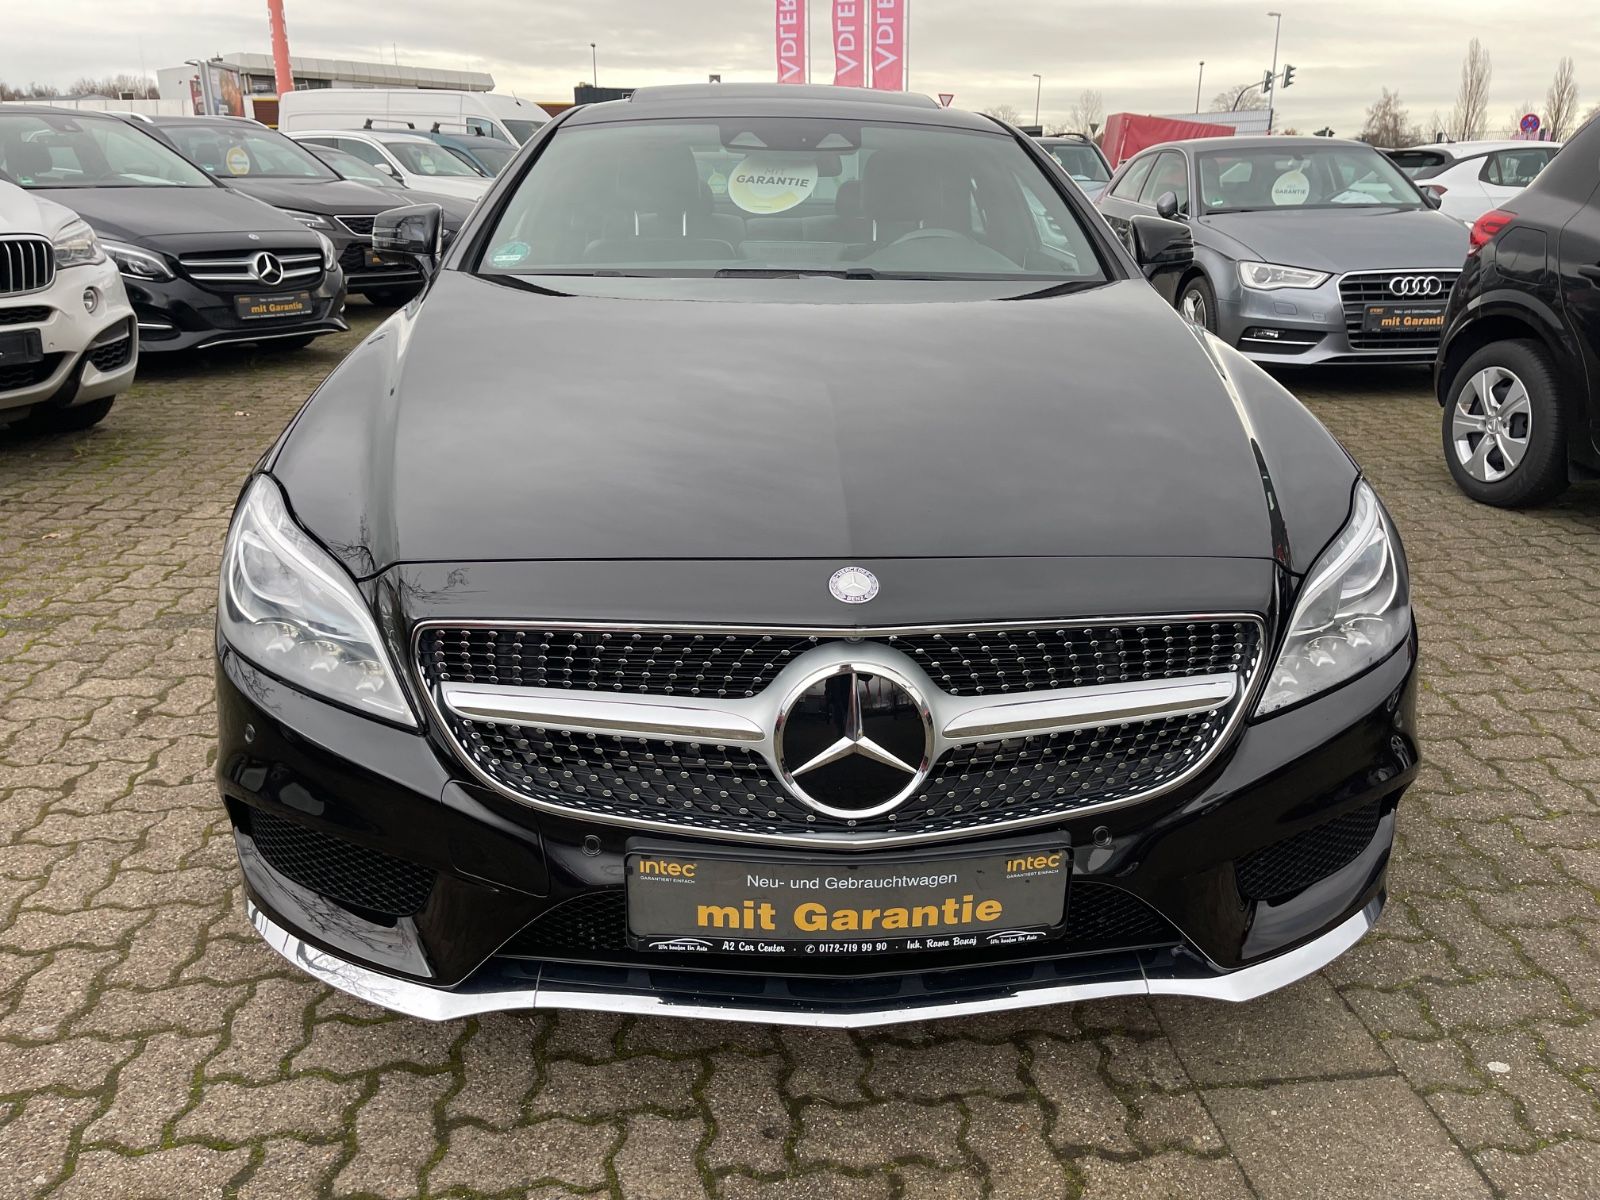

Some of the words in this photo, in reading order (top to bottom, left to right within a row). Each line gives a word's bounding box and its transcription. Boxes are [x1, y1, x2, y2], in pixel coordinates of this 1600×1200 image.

[736, 174, 810, 188] GARANTIE
[251, 304, 267, 313] mit
[269, 301, 303, 312] Garantie
[1381, 315, 1400, 326] mit
[1403, 315, 1445, 326] Garanti
[640, 860, 696, 878] intec
[1007, 854, 1060, 872] intec
[747, 874, 785, 888] Neu-
[790, 877, 819, 889] und
[825, 873, 958, 889] Gebrauchtwagen
[697, 900, 776, 930] mit
[793, 894, 1003, 932] Garantie
[722, 940, 735, 951] A2
[739, 941, 755, 952] Car
[758, 942, 785, 953] Center
[819, 943, 858, 953] 0172-719
[861, 942, 872, 952] 99
[876, 942, 887, 951] 90
[907, 939, 922, 949] Inh.
